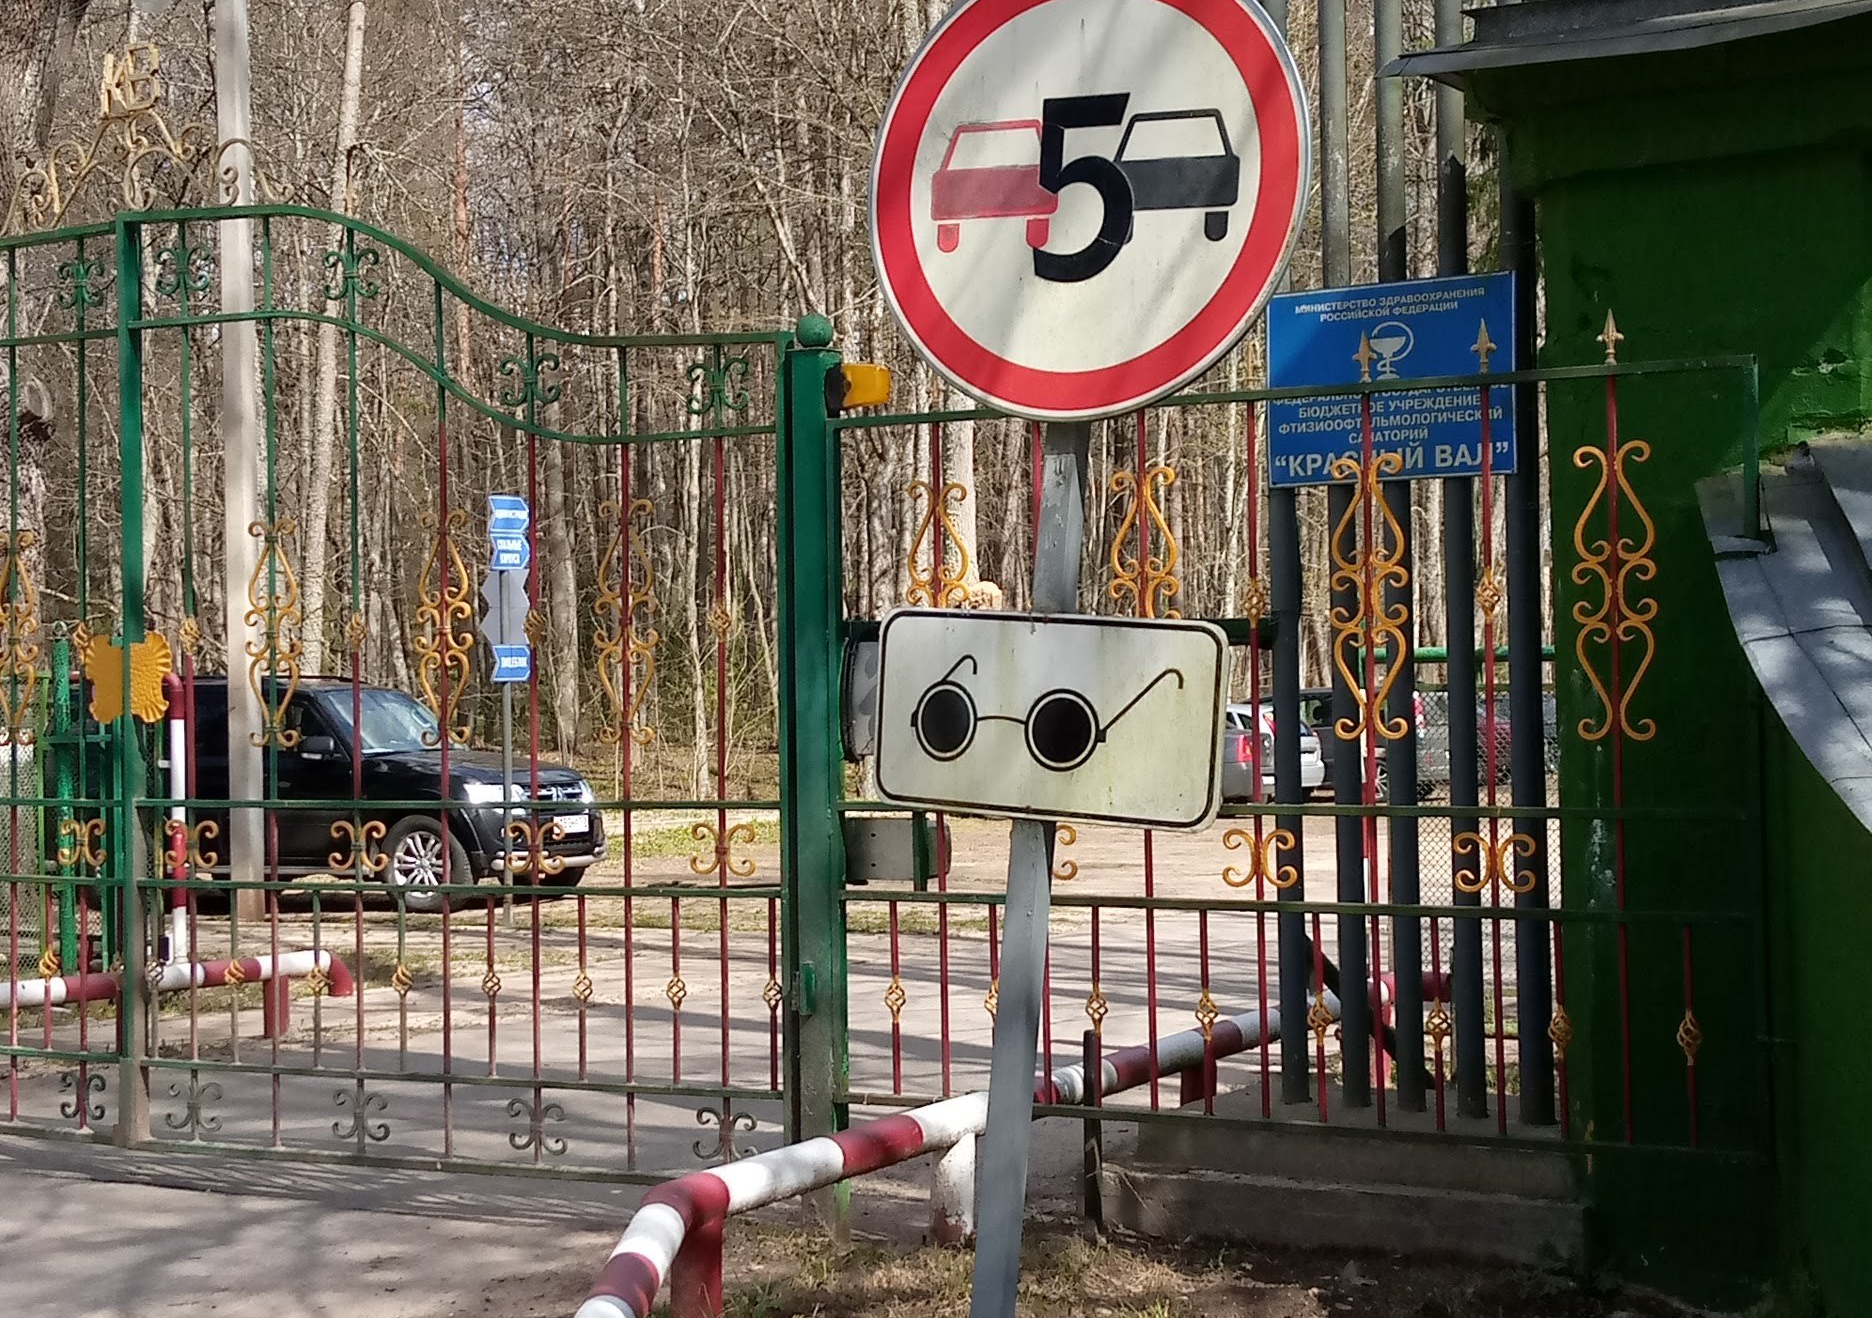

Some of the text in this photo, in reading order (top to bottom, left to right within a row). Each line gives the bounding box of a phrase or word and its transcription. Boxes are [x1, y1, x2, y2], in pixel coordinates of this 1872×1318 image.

[1033, 92, 1134, 283] 5
[1295, 287, 1485, 314] МИНИСТЕРСТВО ЗДРАВООХРАНЕНИЯ
[1320, 300, 1458, 323] РОССИЙСКОЙ ФЕДЕРАЦИИ
[1389, 394, 1481, 412] УЧРЕЖДЕНИЕ
[1278, 406, 1503, 435] ФТИЗИООФТЛЬМОЛОГИЧЕСКЙ
